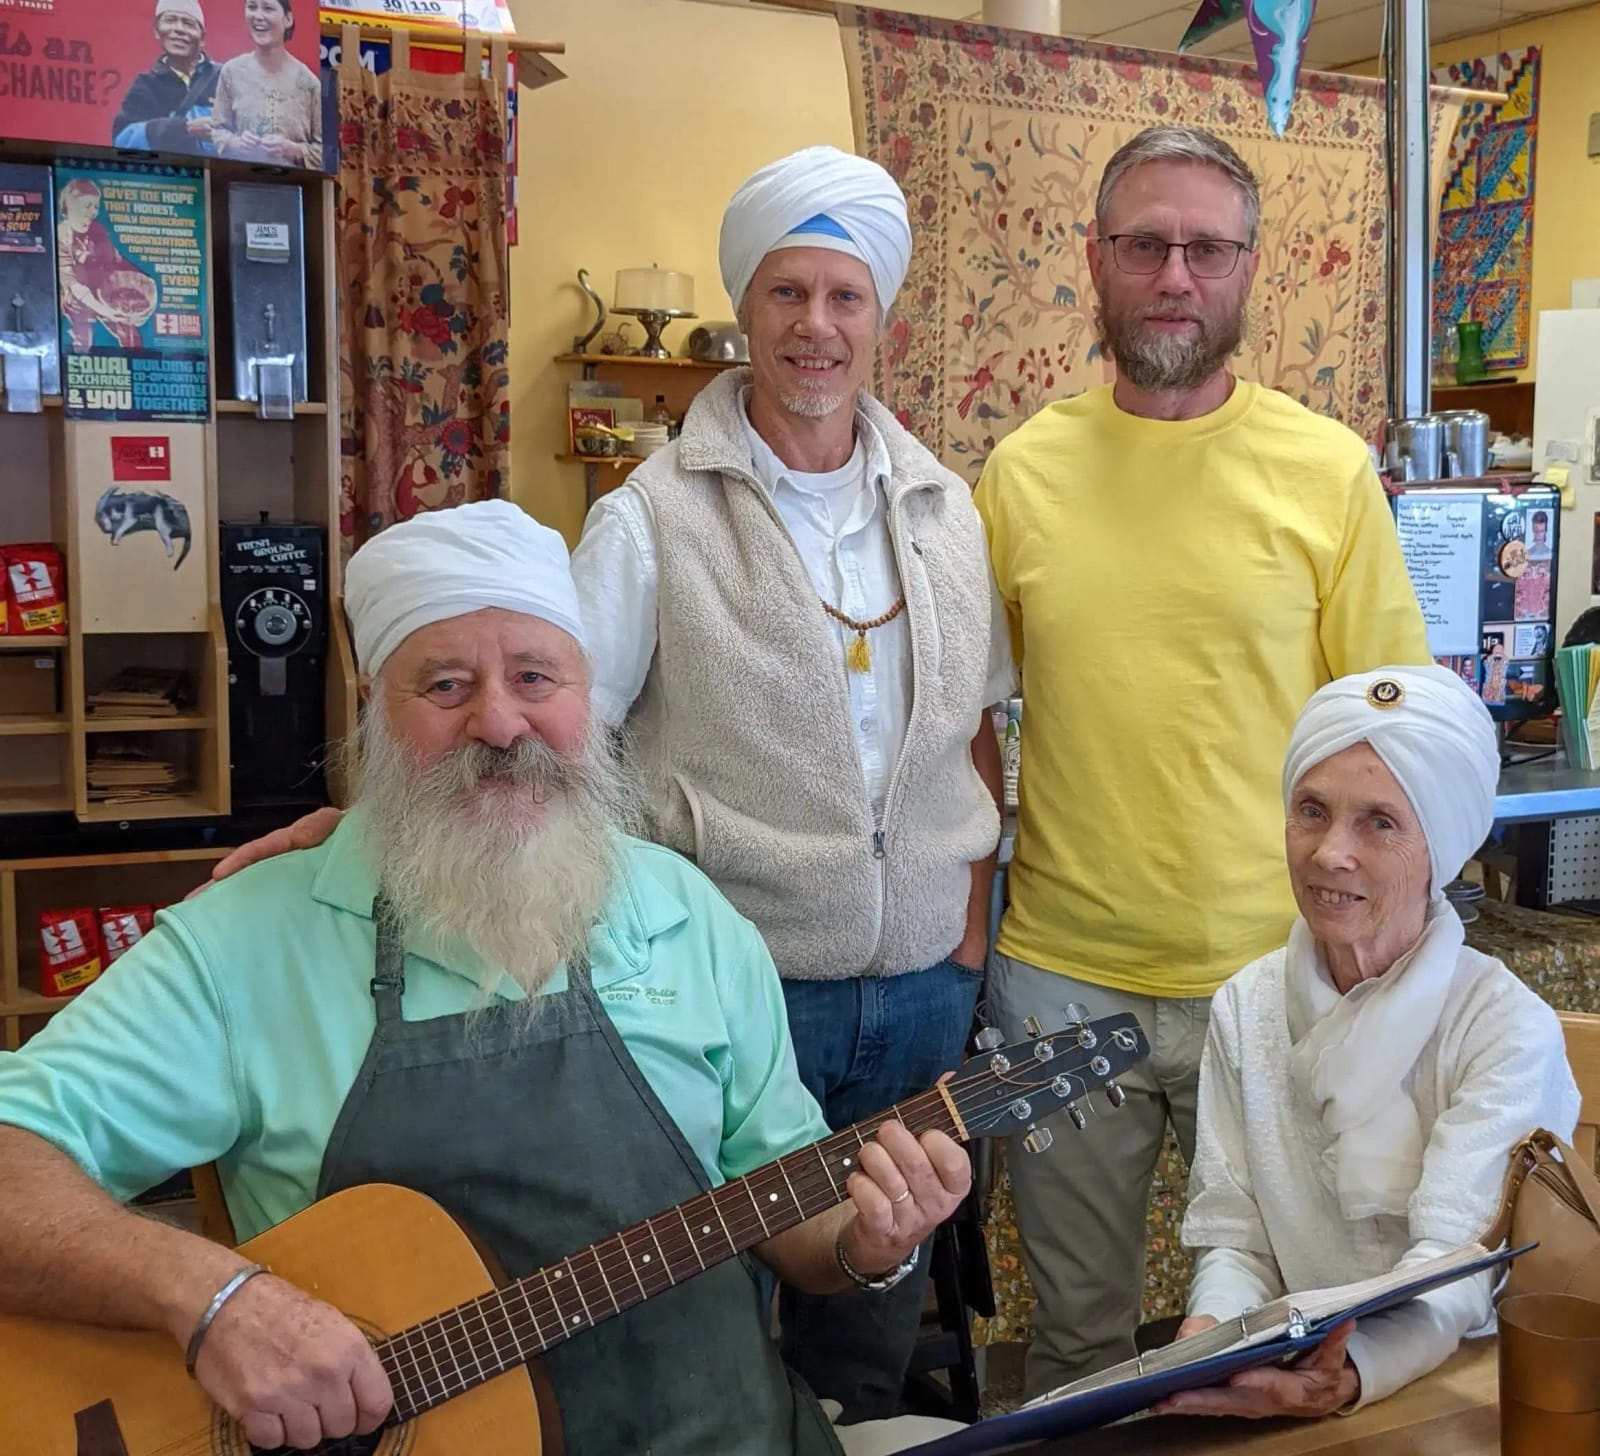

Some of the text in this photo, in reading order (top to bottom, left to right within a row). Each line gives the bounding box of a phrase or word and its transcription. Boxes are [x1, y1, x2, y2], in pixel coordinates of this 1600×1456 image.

[411, 1, 441, 11] 110
[43, 37, 94, 64] an
[0, 61, 121, 107] CHANGE?
[103, 187, 194, 205] GIVES ME HOPE
[104, 201, 178, 217] THAT HONEST,
[16, 212, 40, 221] BODY
[6, 221, 32, 231] SOUL
[120, 234, 197, 248] ORGANIZATIONS
[155, 263, 199, 275] RESPECTS
[161, 275, 199, 287] EVERY
[68, 355, 131, 375] EQUAL
[132, 358, 206, 373] BUILDING A
[68, 373, 131, 386] EXCHANGE
[133, 372, 206, 384] CO-OPERATIVE
[134, 383, 206, 397] ECONOMY
[69, 389, 132, 409] & YOU
[134, 396, 207, 412] TOGETHER
[237, 538, 270, 551] FRESH
[253, 543, 295, 557] GROUND
[271, 549, 308, 562] COFFEE
[607, 993, 676, 1006] GOLF CLUB
